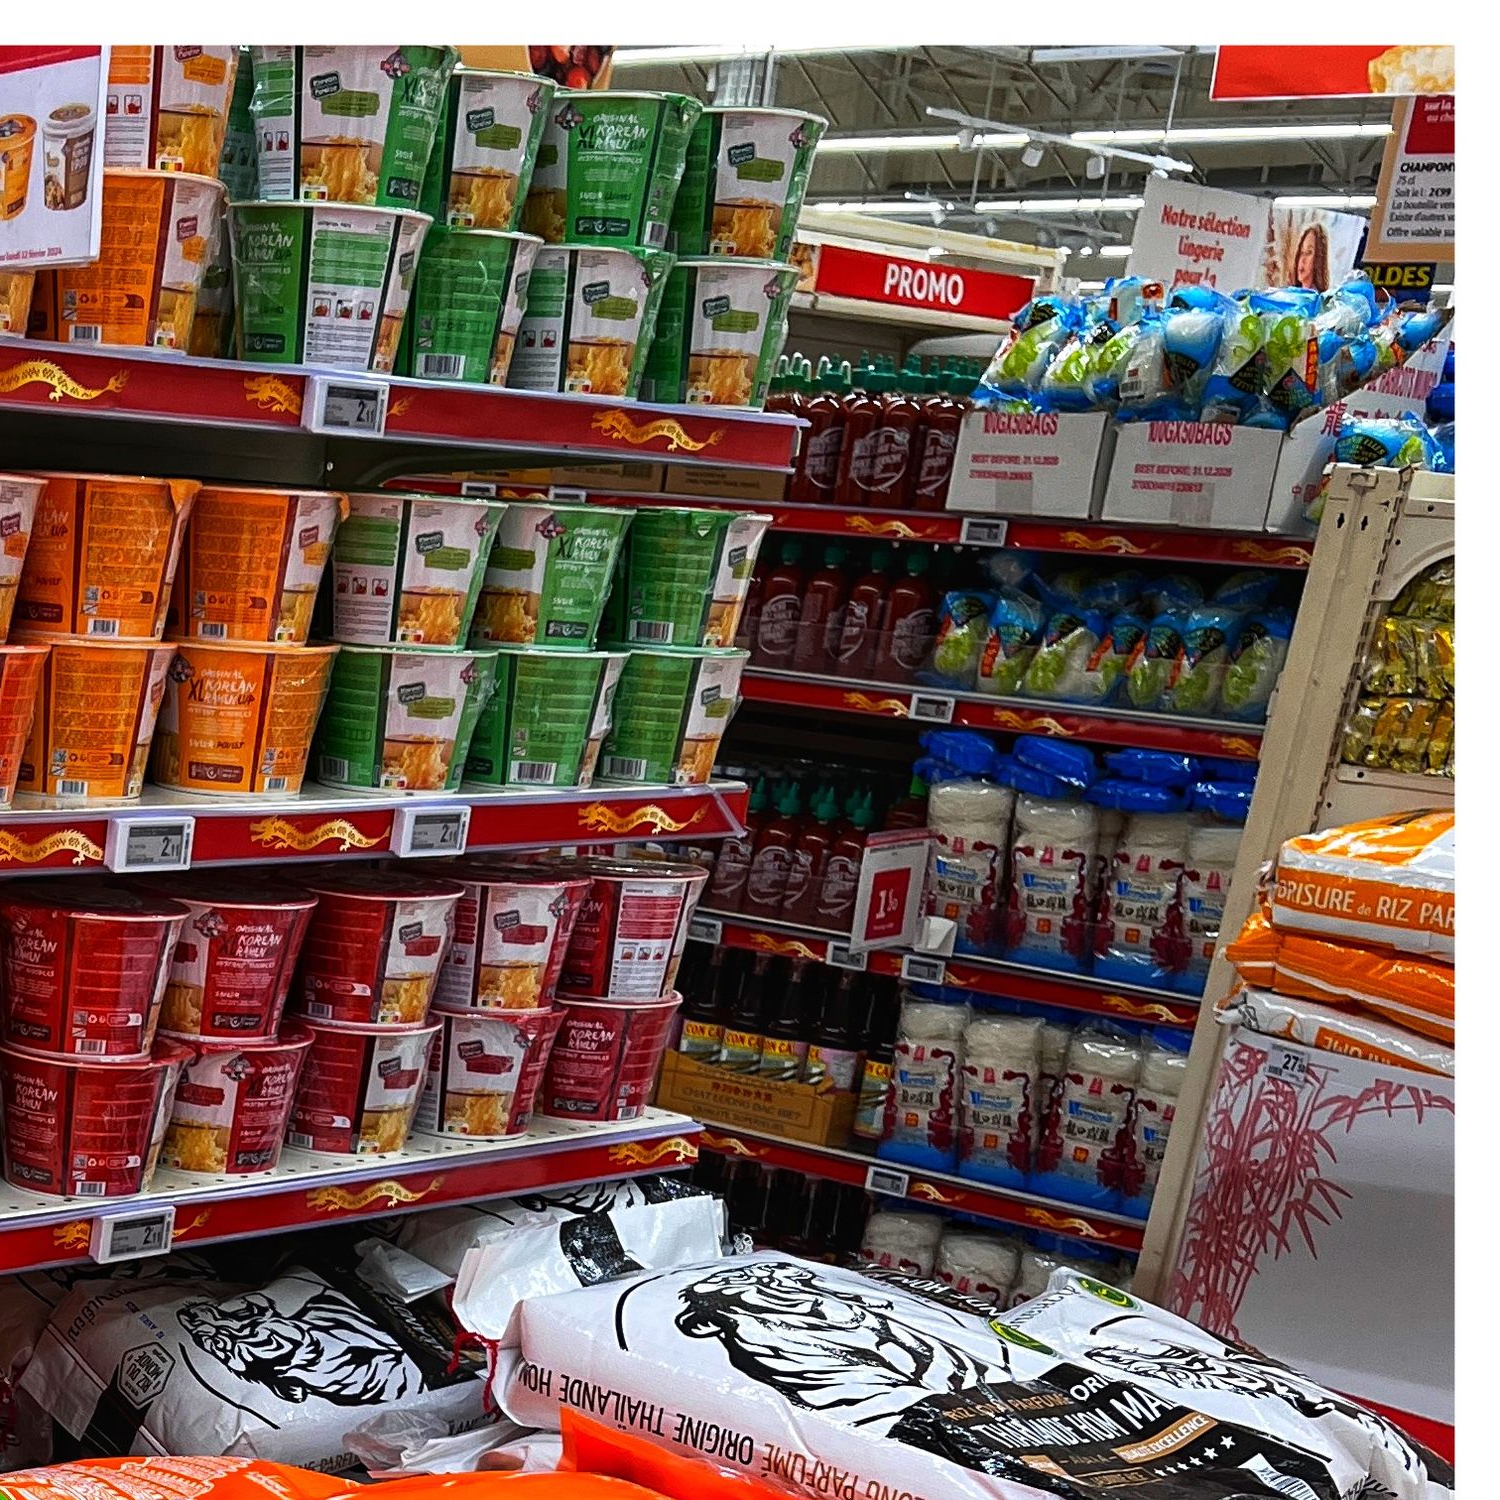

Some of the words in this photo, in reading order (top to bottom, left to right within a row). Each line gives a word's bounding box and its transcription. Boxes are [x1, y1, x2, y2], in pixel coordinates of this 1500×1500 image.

[1161, 204, 1198, 228] Notre
[1196, 210, 1251, 240] sélection
[1178, 235, 1224, 262] Lingerie
[884, 262, 964, 306] PROMO
[1362, 266, 1431, 287] OLDES
[1275, 878, 1354, 914] BRISURE
[1376, 897, 1413, 923] RIZ
[1419, 902, 1454, 928] PAR
[558, 1374, 665, 1437] THAÏLANDE
[676, 1413, 754, 1465] ORIGINE
[1152, 1415, 1209, 1454] EXCELLENCE
